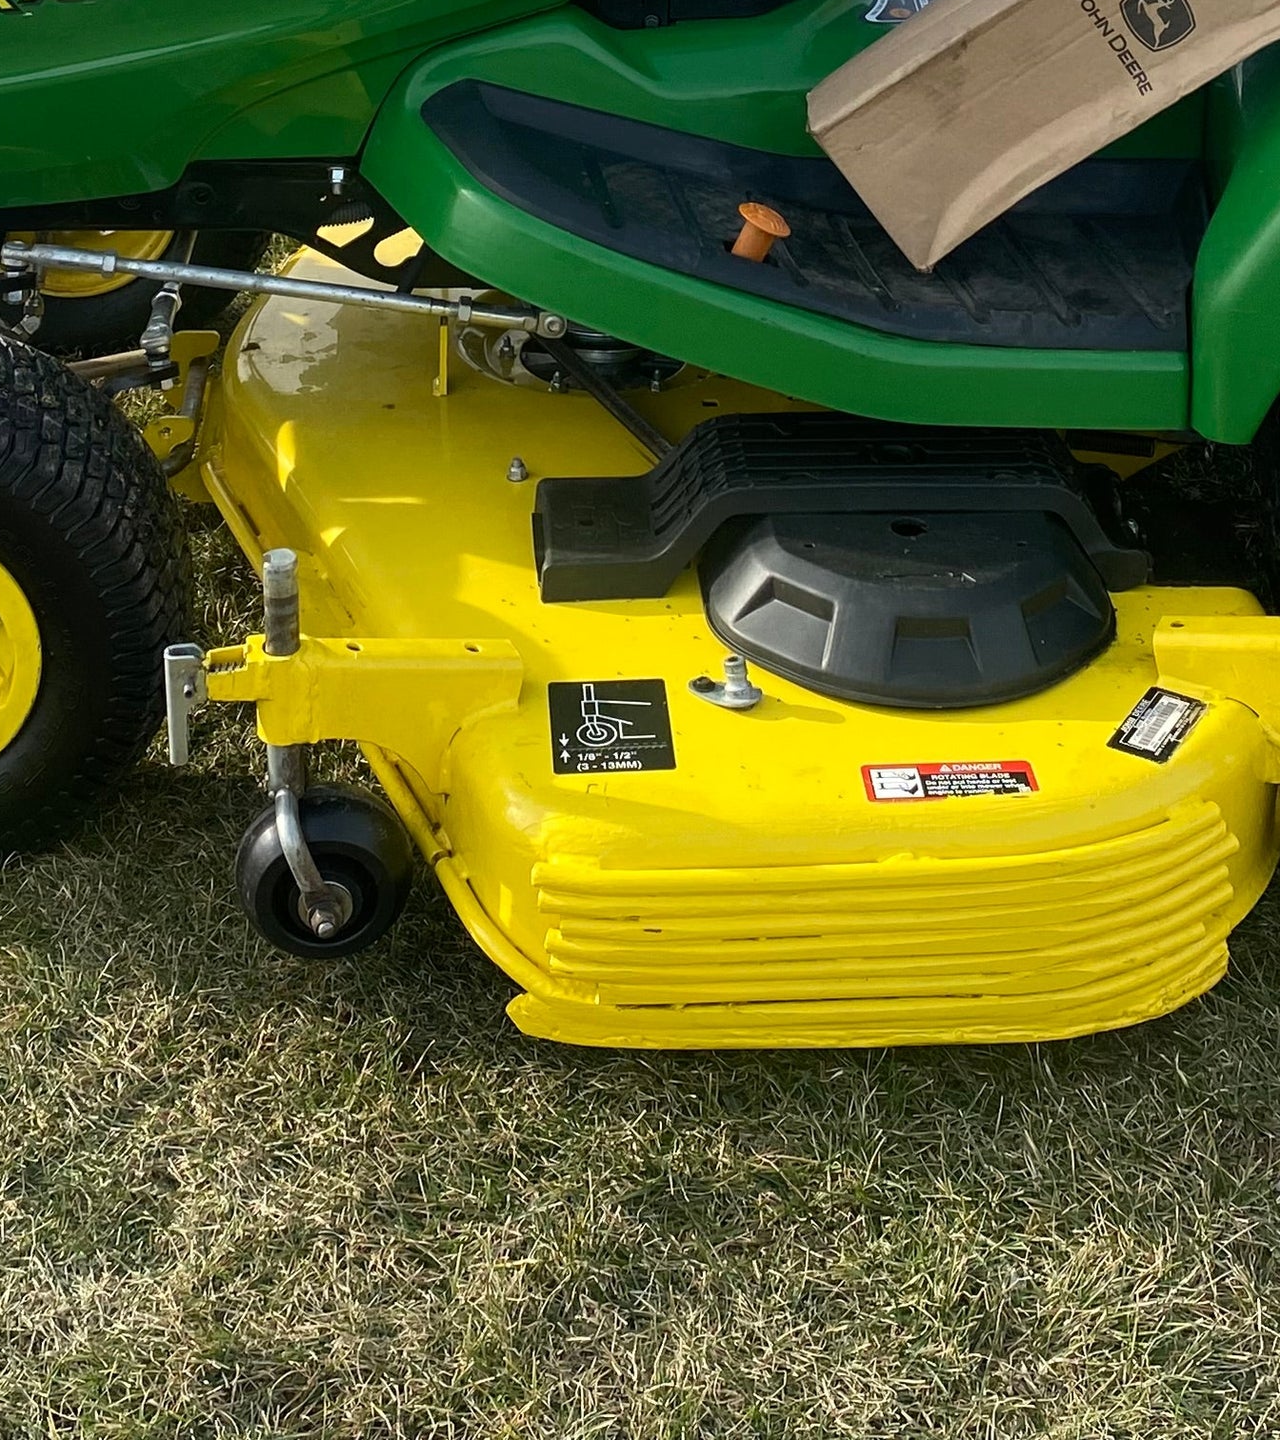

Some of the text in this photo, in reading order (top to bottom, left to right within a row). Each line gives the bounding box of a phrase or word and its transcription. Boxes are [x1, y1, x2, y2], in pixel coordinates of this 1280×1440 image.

[1108, 34, 1153, 96] DEERE
[613, 751, 638, 760] 1/2"
[601, 761, 643, 770] 13MM)
[951, 763, 1002, 771] DANGER
